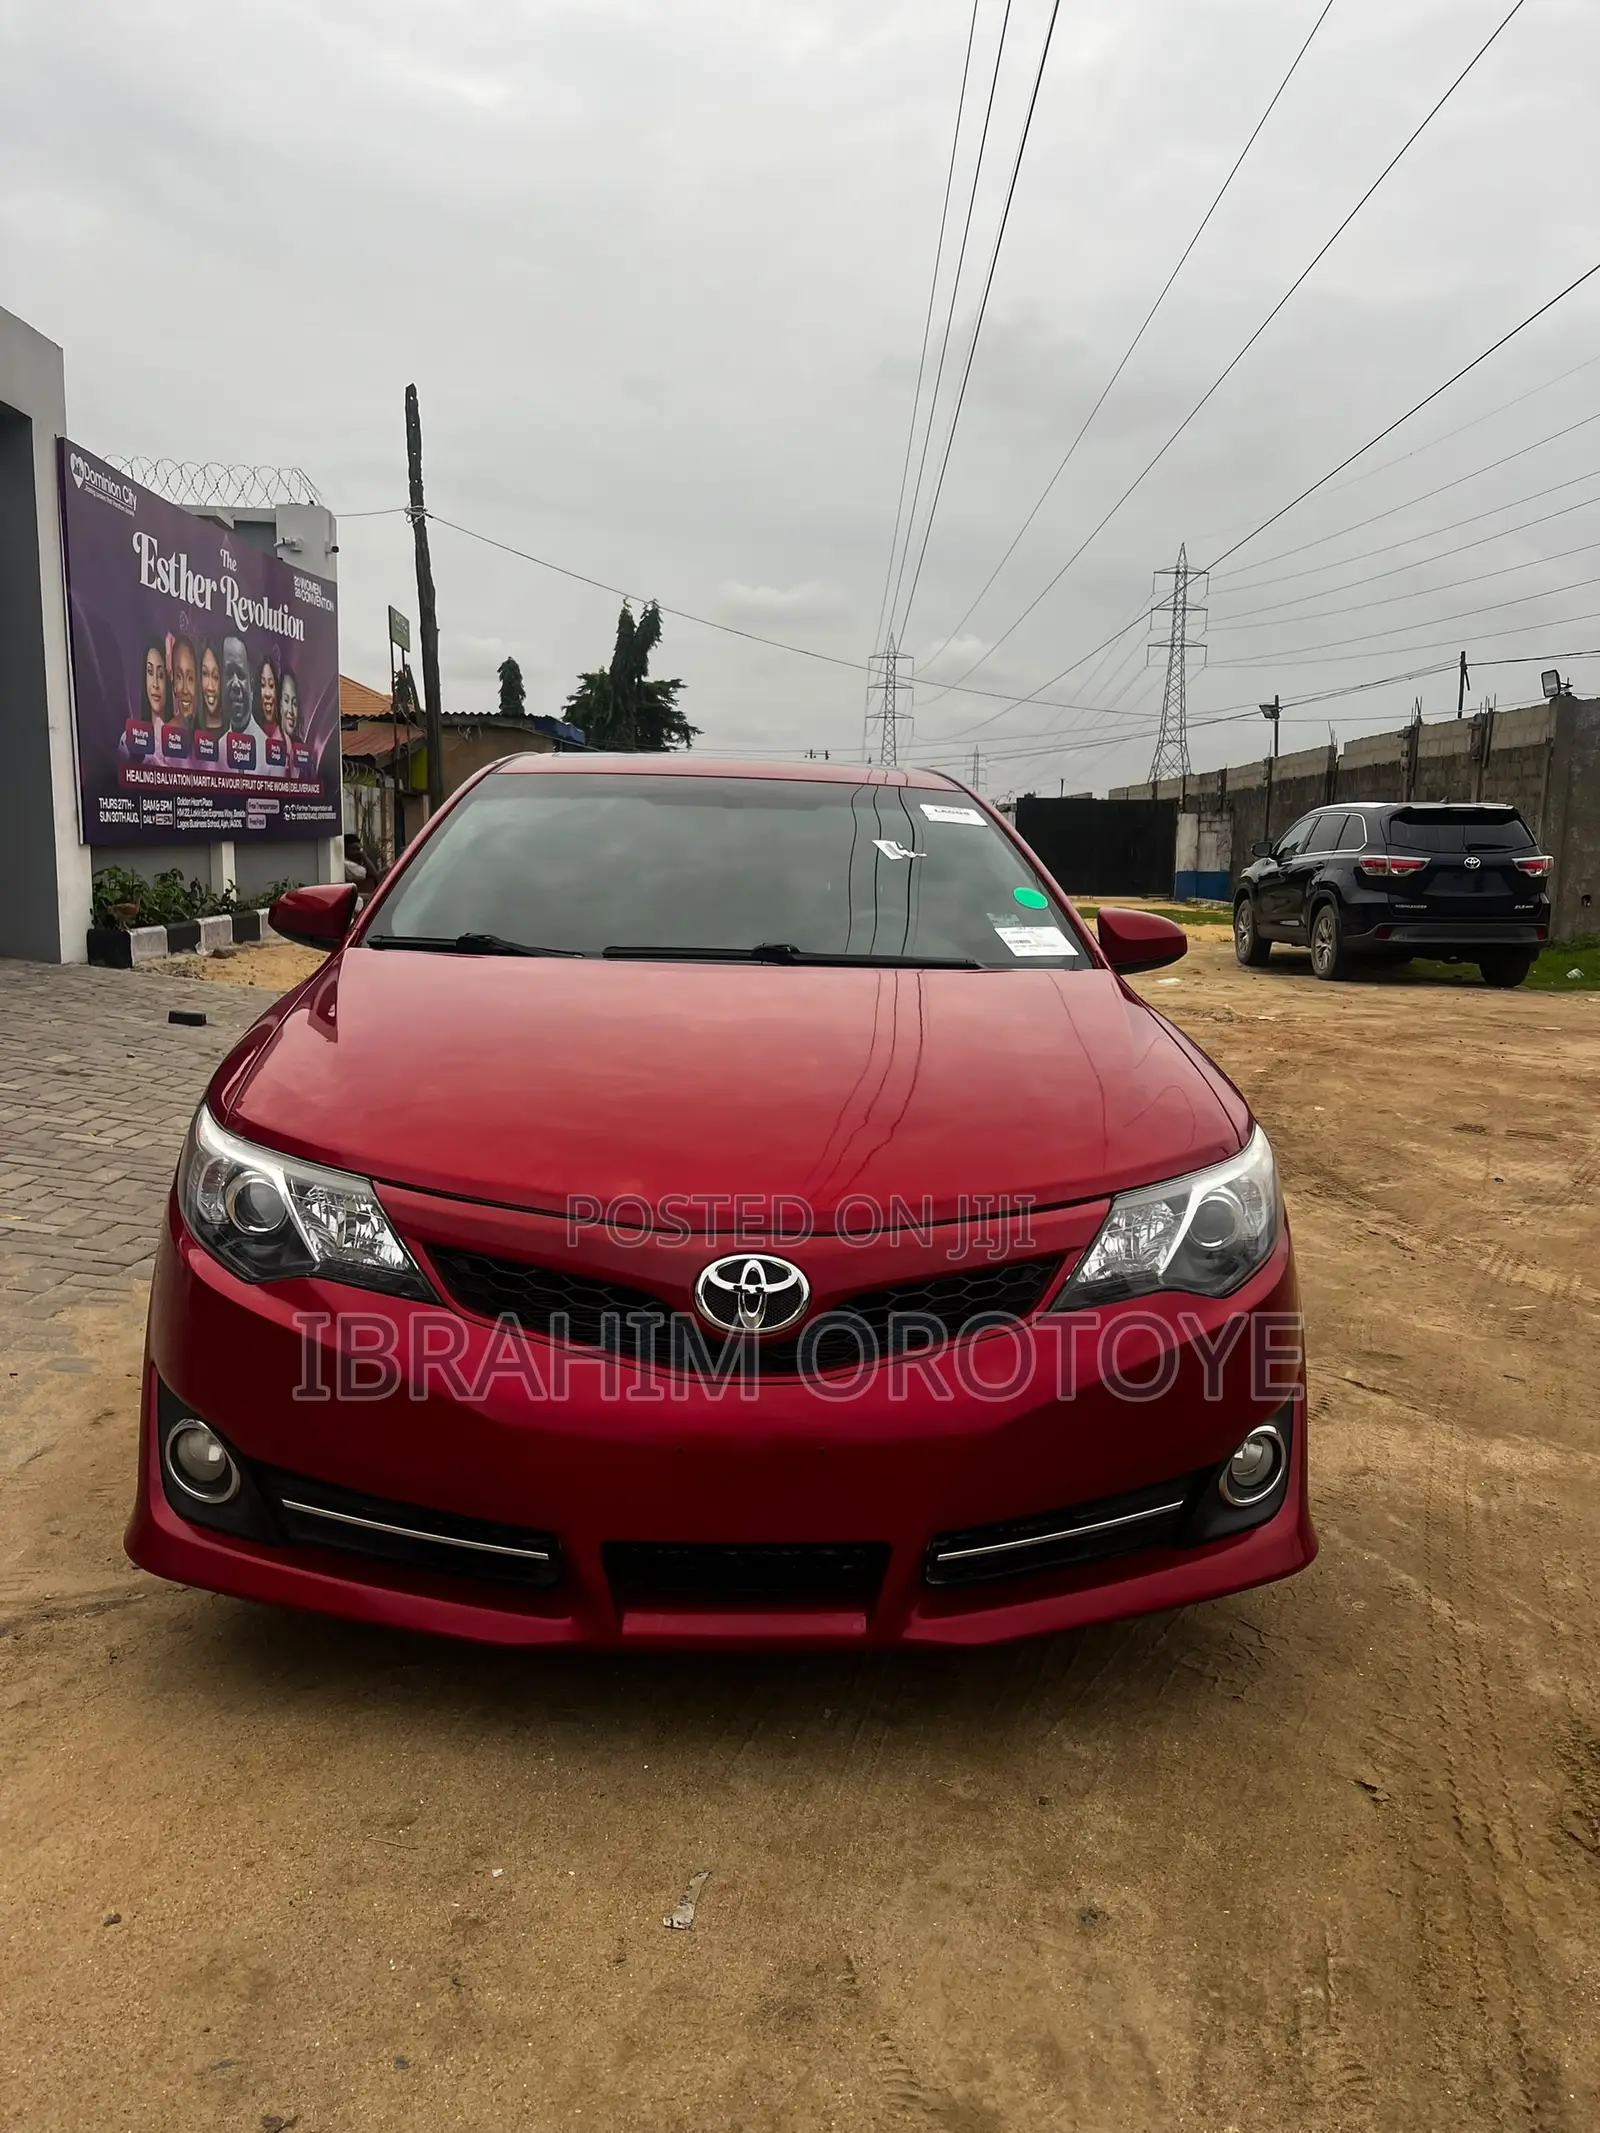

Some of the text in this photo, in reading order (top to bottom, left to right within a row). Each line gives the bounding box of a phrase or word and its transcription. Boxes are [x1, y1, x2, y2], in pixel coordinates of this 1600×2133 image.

[84, 461, 122, 501] Dominion
[122, 485, 137, 511] City
[132, 531, 218, 611] Esther
[220, 548, 239, 572] The
[300, 577, 322, 596] WOMEN
[220, 575, 305, 642] Revolution
[301, 589, 335, 613] CONVENTION
[126, 769, 321, 794] HEALING SALVATION MARITAL FAVOUR FRUIT OF THE WOMB DELIVERANCE
[98, 797, 118, 810] THURS
[142, 799, 156, 811] 8AM
[160, 800, 173, 811] 5PM
[99, 811, 112, 823] SUN
[112, 811, 126, 823] 30TH
